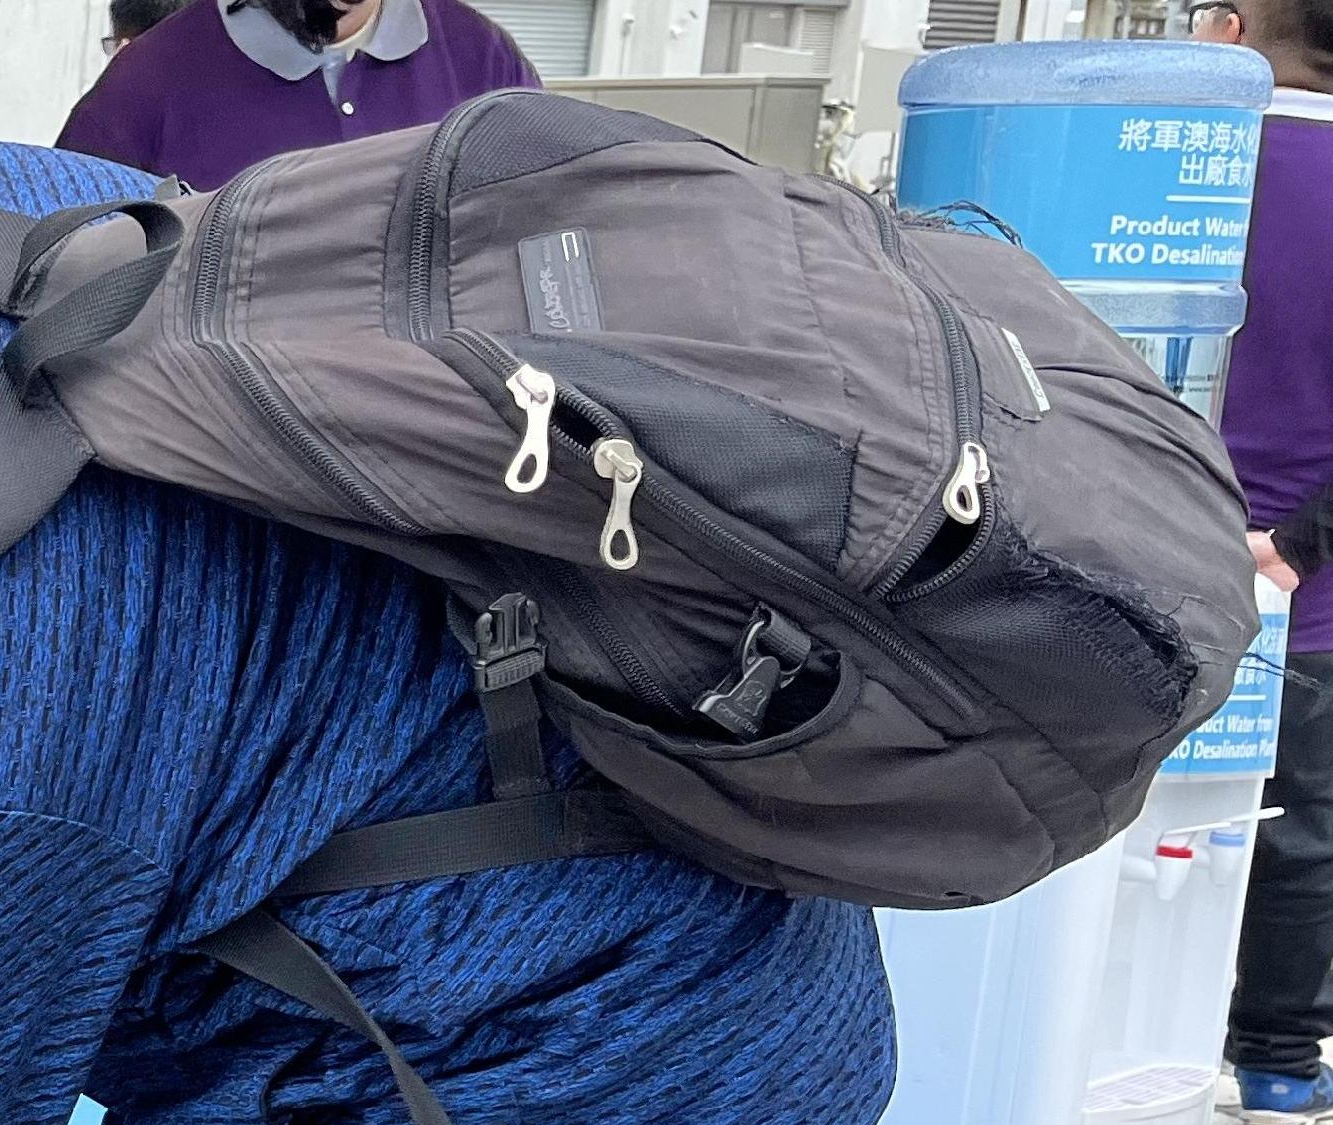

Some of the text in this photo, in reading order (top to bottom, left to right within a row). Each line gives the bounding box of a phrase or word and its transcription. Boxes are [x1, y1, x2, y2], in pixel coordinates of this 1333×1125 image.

[1109, 214, 1201, 236] Product
[1205, 216, 1243, 238] Water
[1091, 242, 1146, 264] TKO
